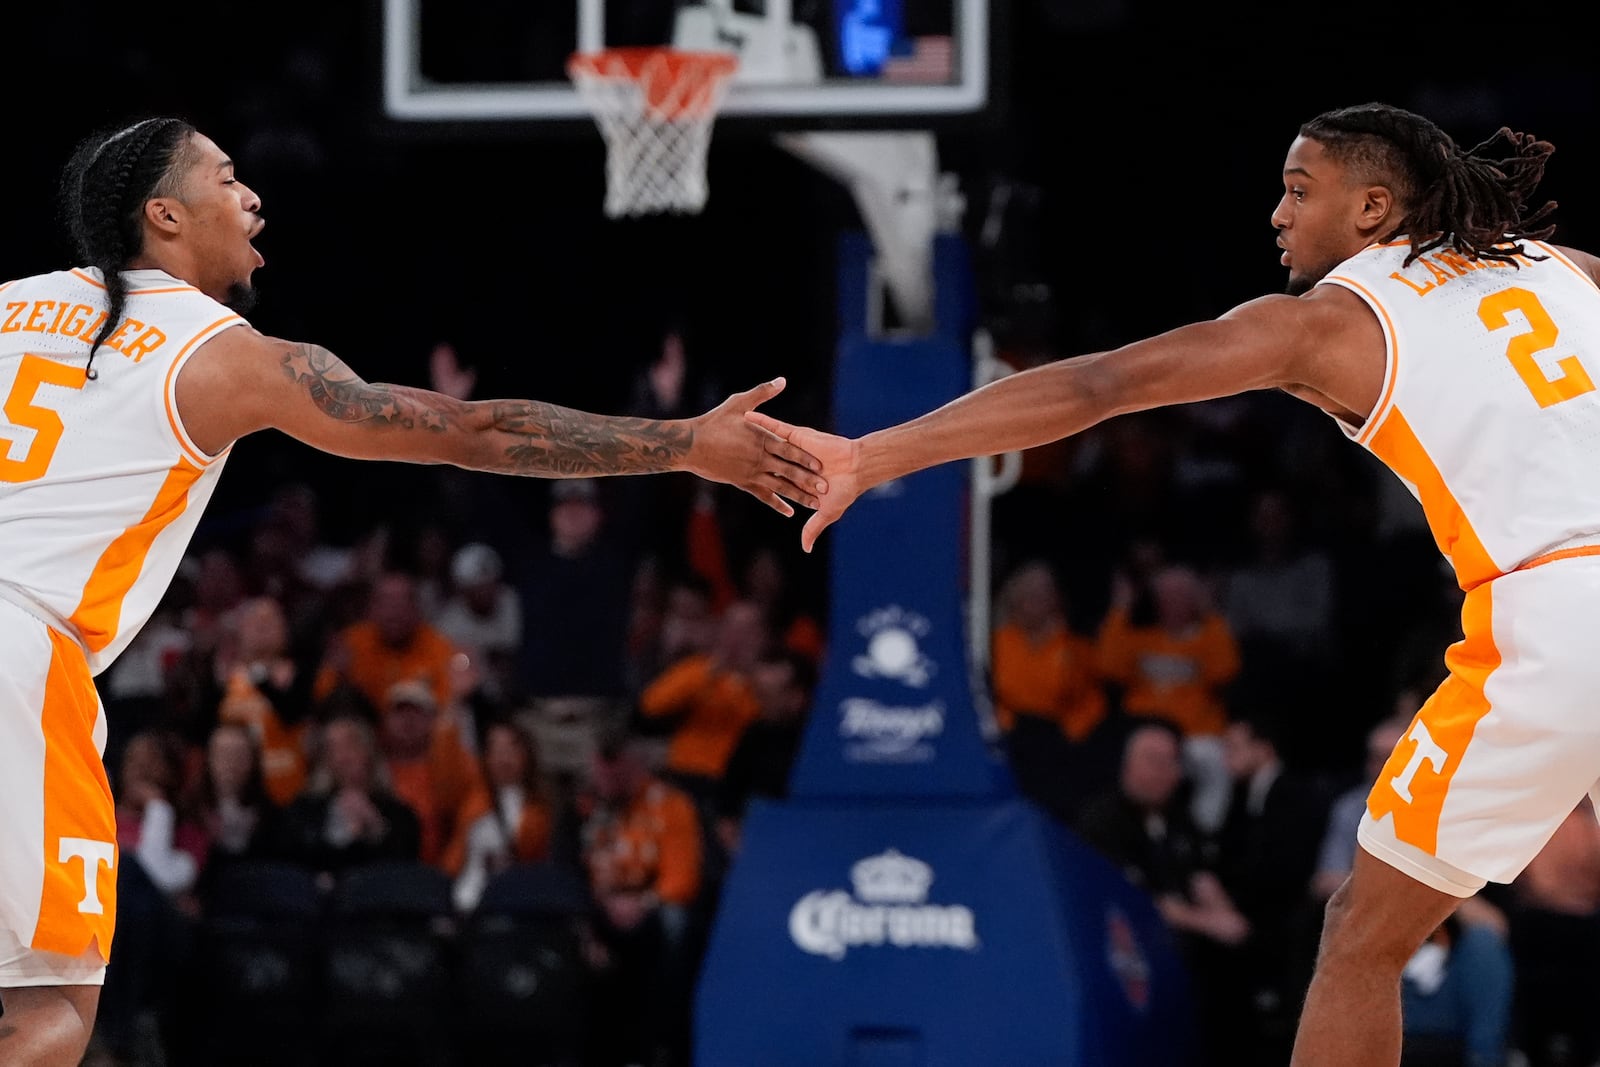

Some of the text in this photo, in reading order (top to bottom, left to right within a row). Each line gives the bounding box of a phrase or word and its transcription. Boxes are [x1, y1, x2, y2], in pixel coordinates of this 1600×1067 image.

[1389, 242, 1532, 297] LAN
[1, 300, 167, 364] ZEIGLER
[1477, 287, 1597, 409] 2
[0, 352, 88, 483] 5
[1390, 718, 1449, 805] T
[58, 837, 115, 915] T
